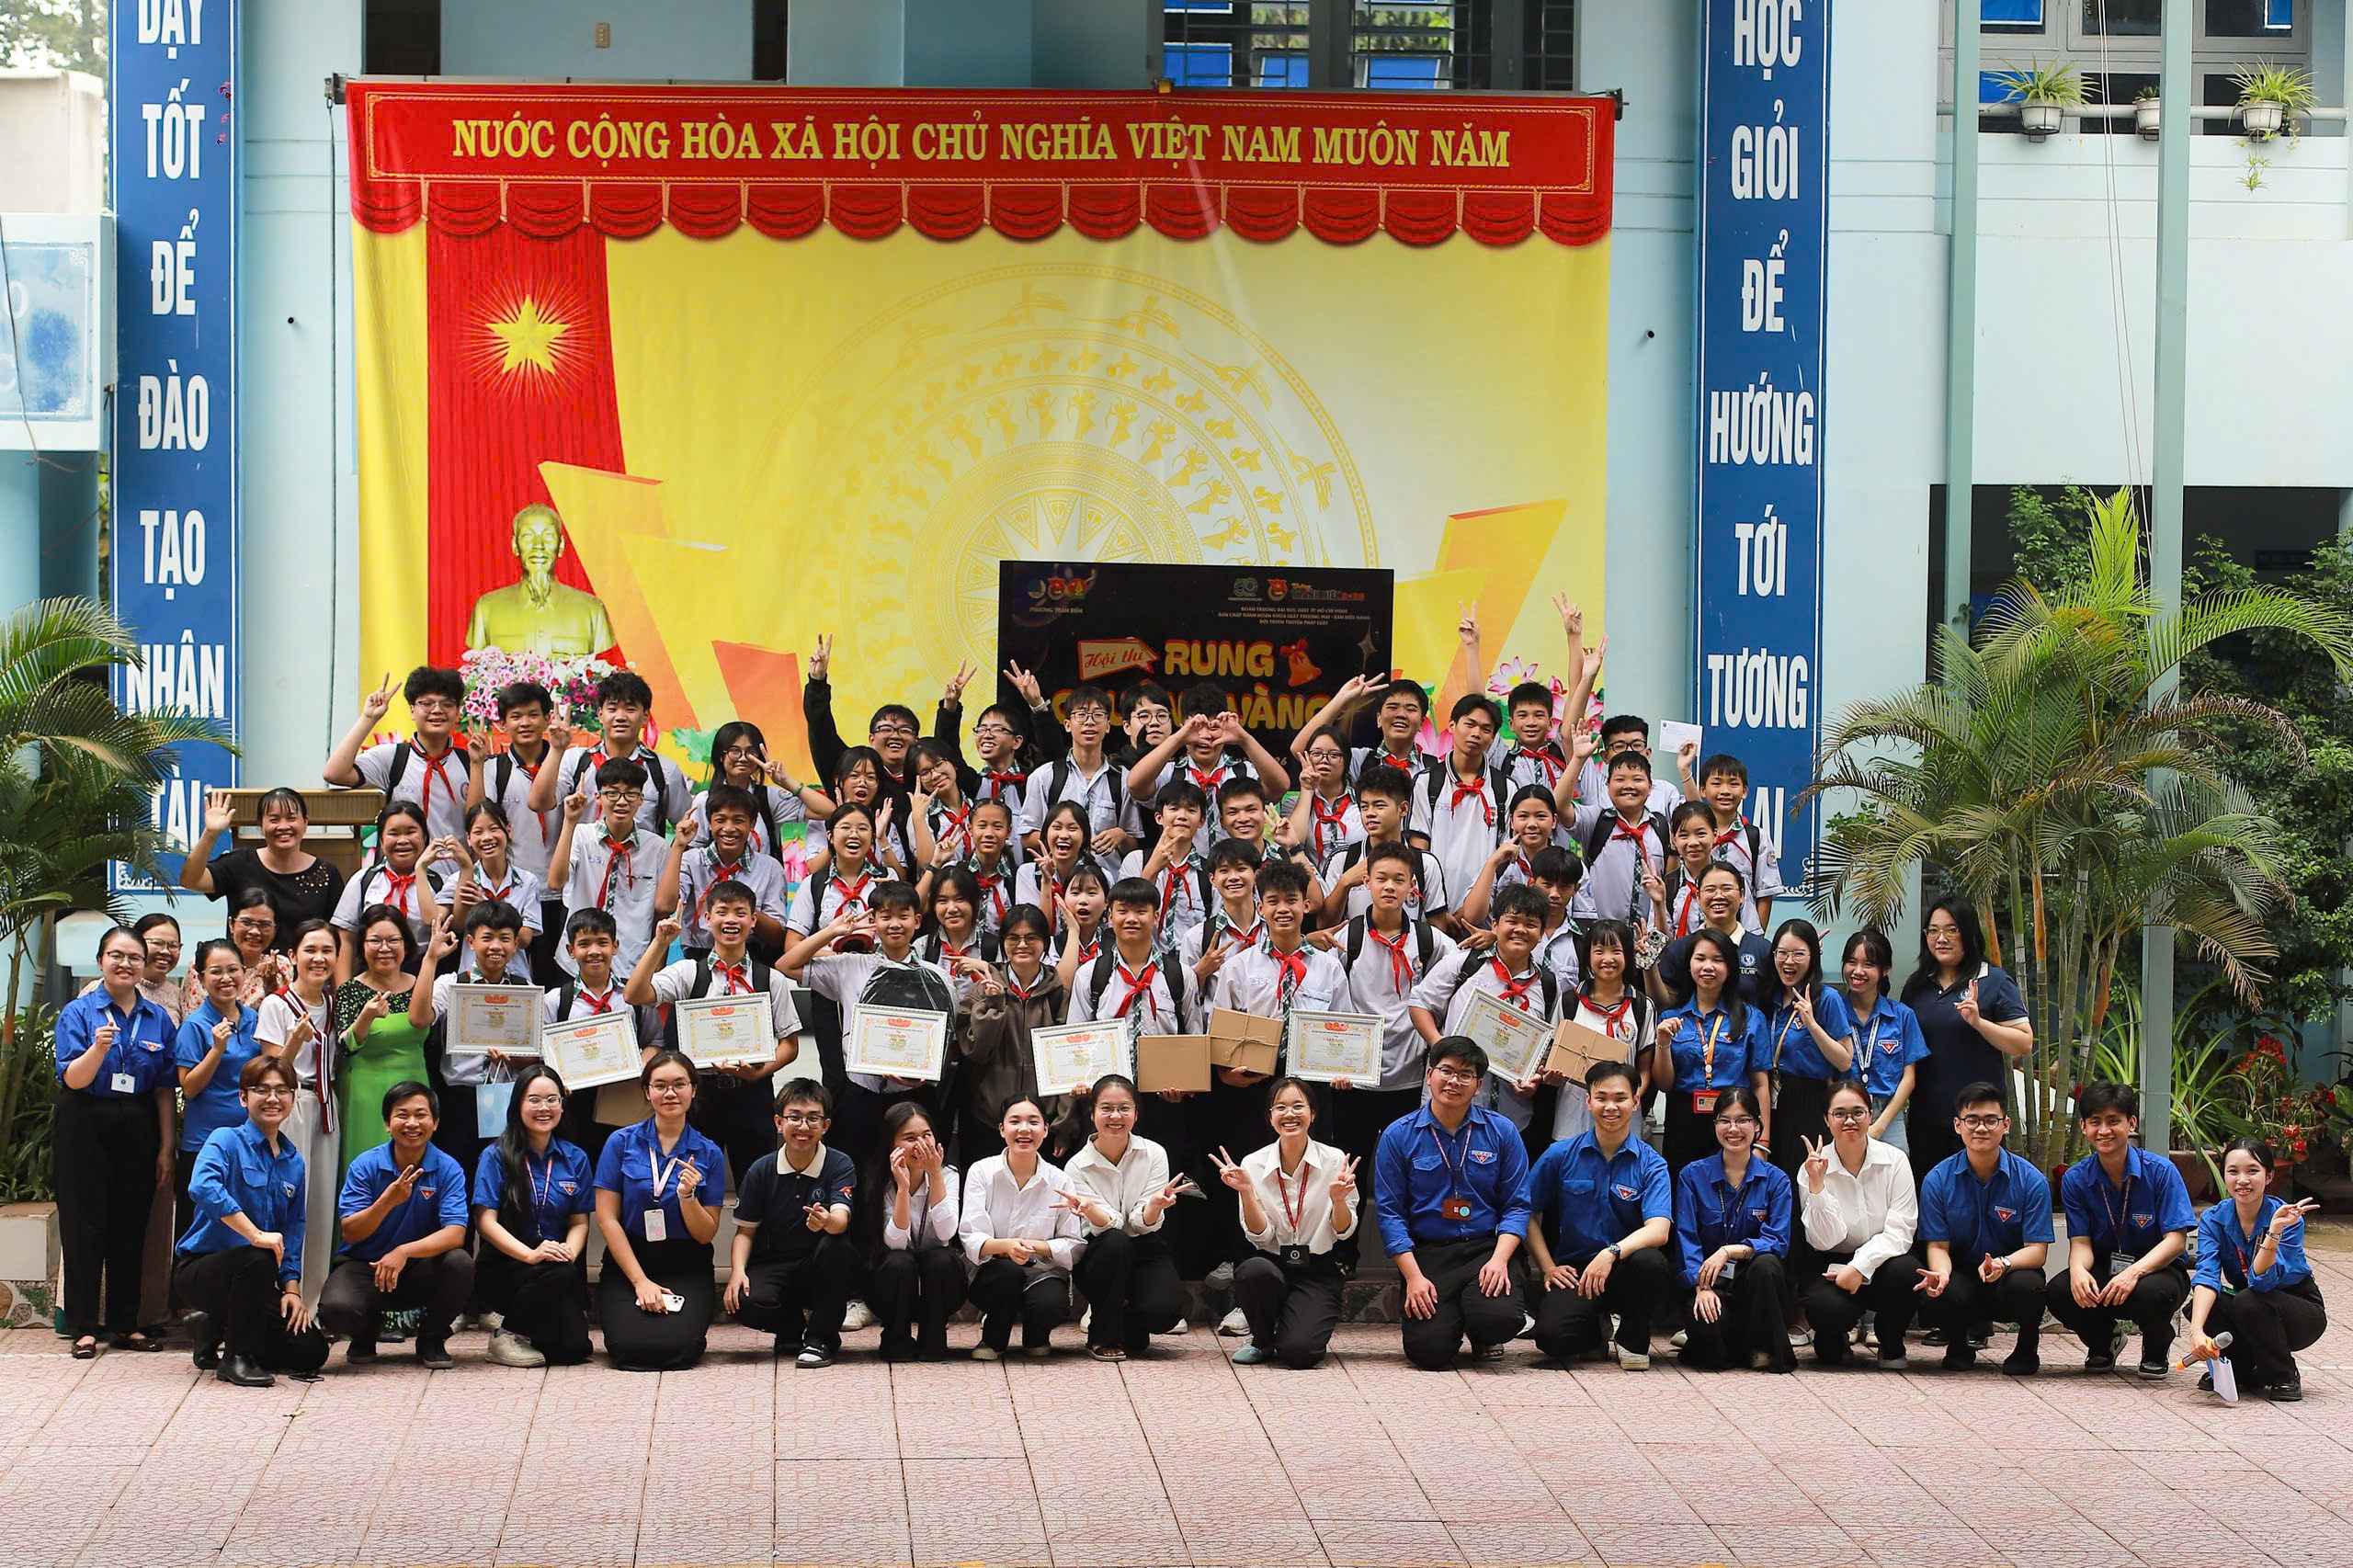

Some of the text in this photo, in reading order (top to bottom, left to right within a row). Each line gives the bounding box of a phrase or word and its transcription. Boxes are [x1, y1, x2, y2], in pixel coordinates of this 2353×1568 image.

[139, 0, 202, 59] DẠY
[1734, 0, 1802, 80] HỌC
[142, 78, 205, 179] TỐT
[453, 109, 1510, 169] NƯỚC CỘNG HÒA XÃ HỘI CHỦ NGHĨA VIỆT NAM MUÔN NĂM
[1732, 99, 1799, 200] GIỎI
[151, 209, 199, 315] ĐỂ
[1742, 229, 1789, 332] ĐỂ
[139, 359, 209, 450] ĐÀO
[1710, 372, 1814, 465] HƯỚNG
[140, 510, 206, 600] TẠO
[1735, 505, 1787, 596] TỚI
[126, 630, 225, 718] NHÂN
[1084, 648, 1144, 670] Hội thi
[1164, 640, 1274, 677] RUNG
[1708, 648, 1808, 728] TƯƠNG
[1736, 786, 1785, 858] AI
